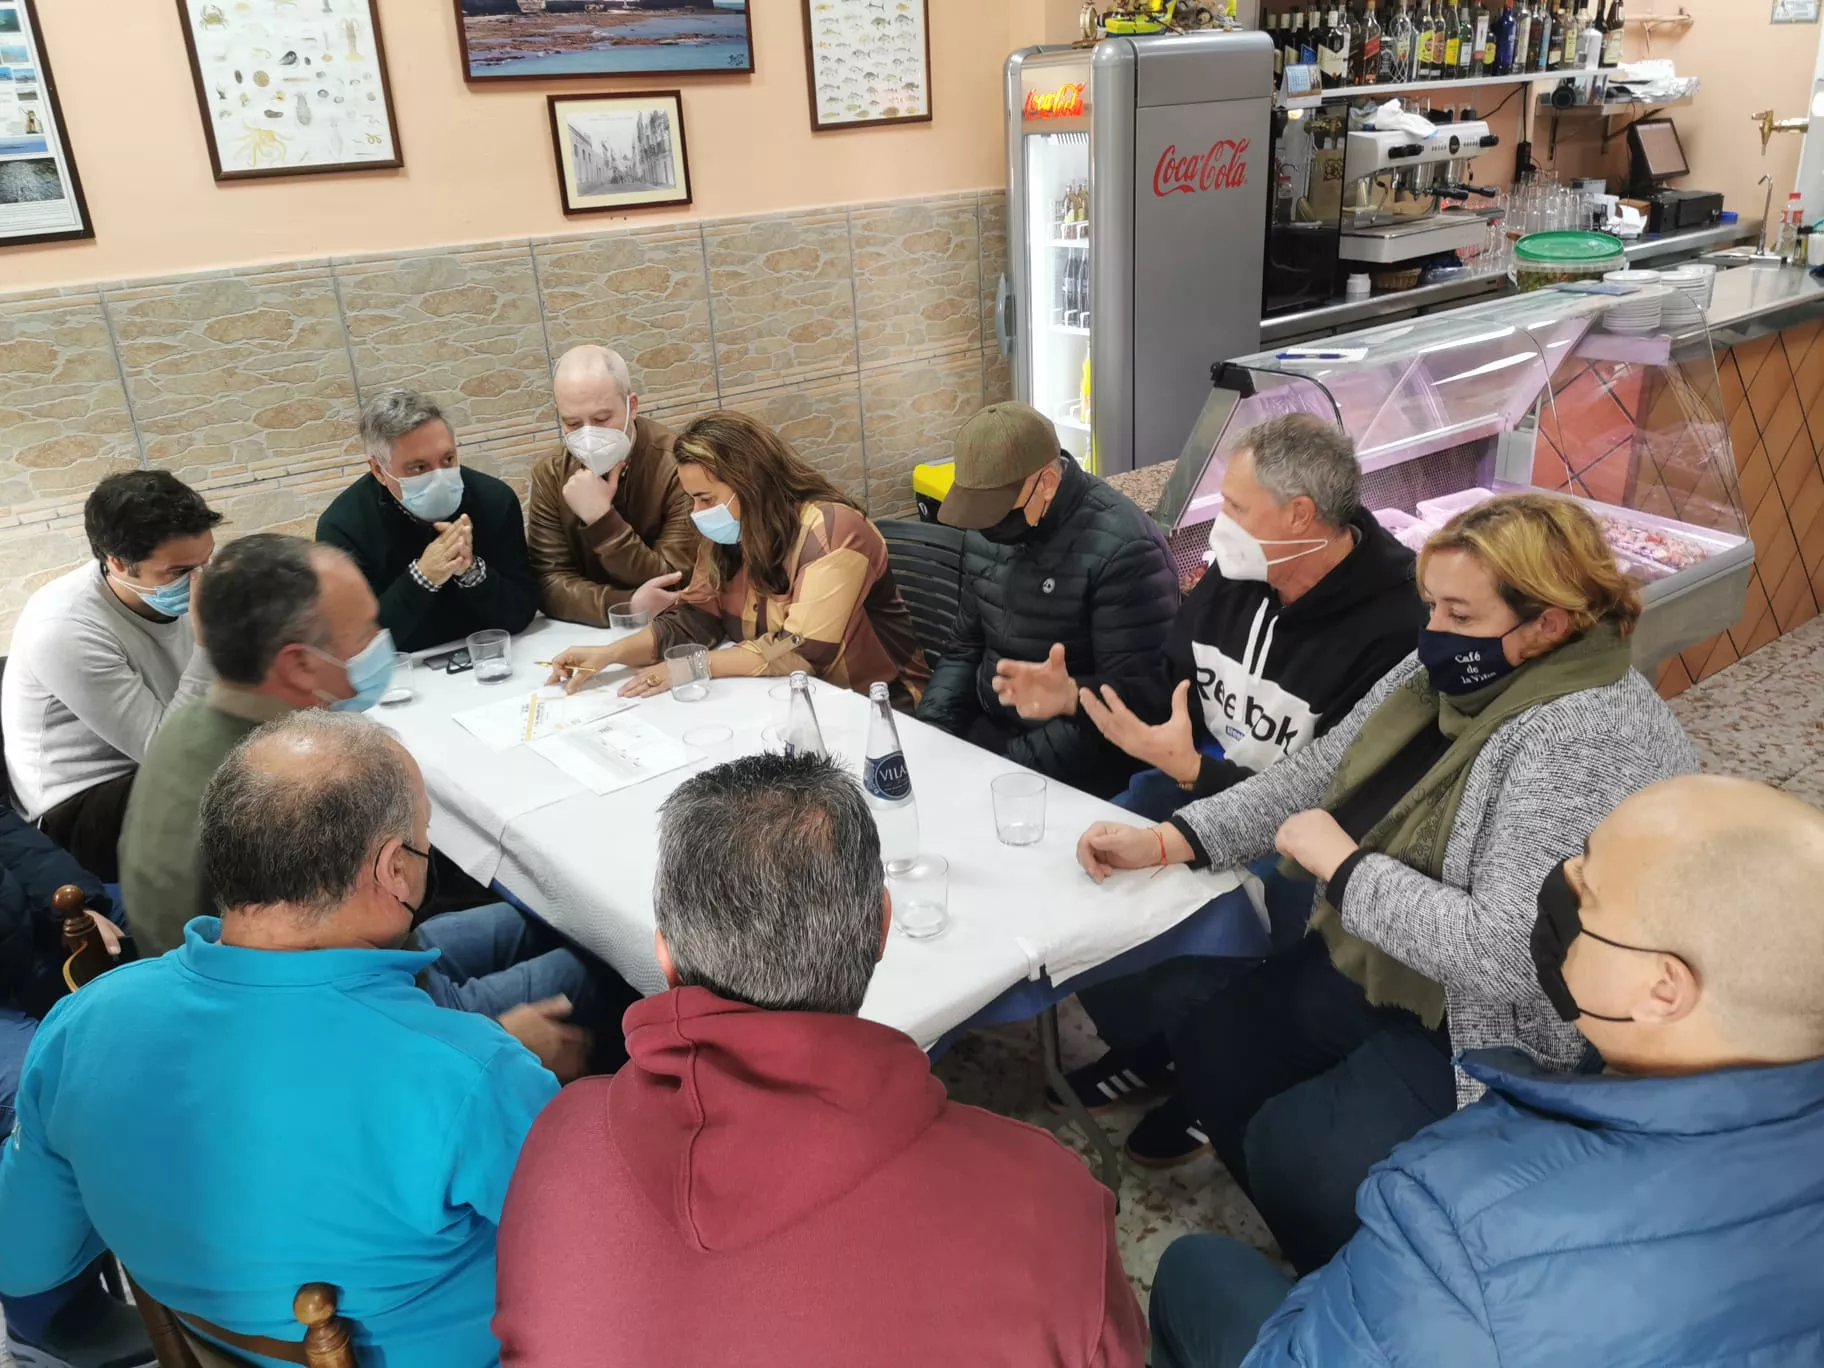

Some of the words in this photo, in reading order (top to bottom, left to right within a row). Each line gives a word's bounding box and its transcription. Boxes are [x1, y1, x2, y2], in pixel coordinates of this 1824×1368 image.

[1153, 138, 1250, 197] Coca-Cola
[1455, 651, 1480, 663] Café
[1467, 664, 1479, 674] de
[1196, 667, 1299, 755] Reebok
